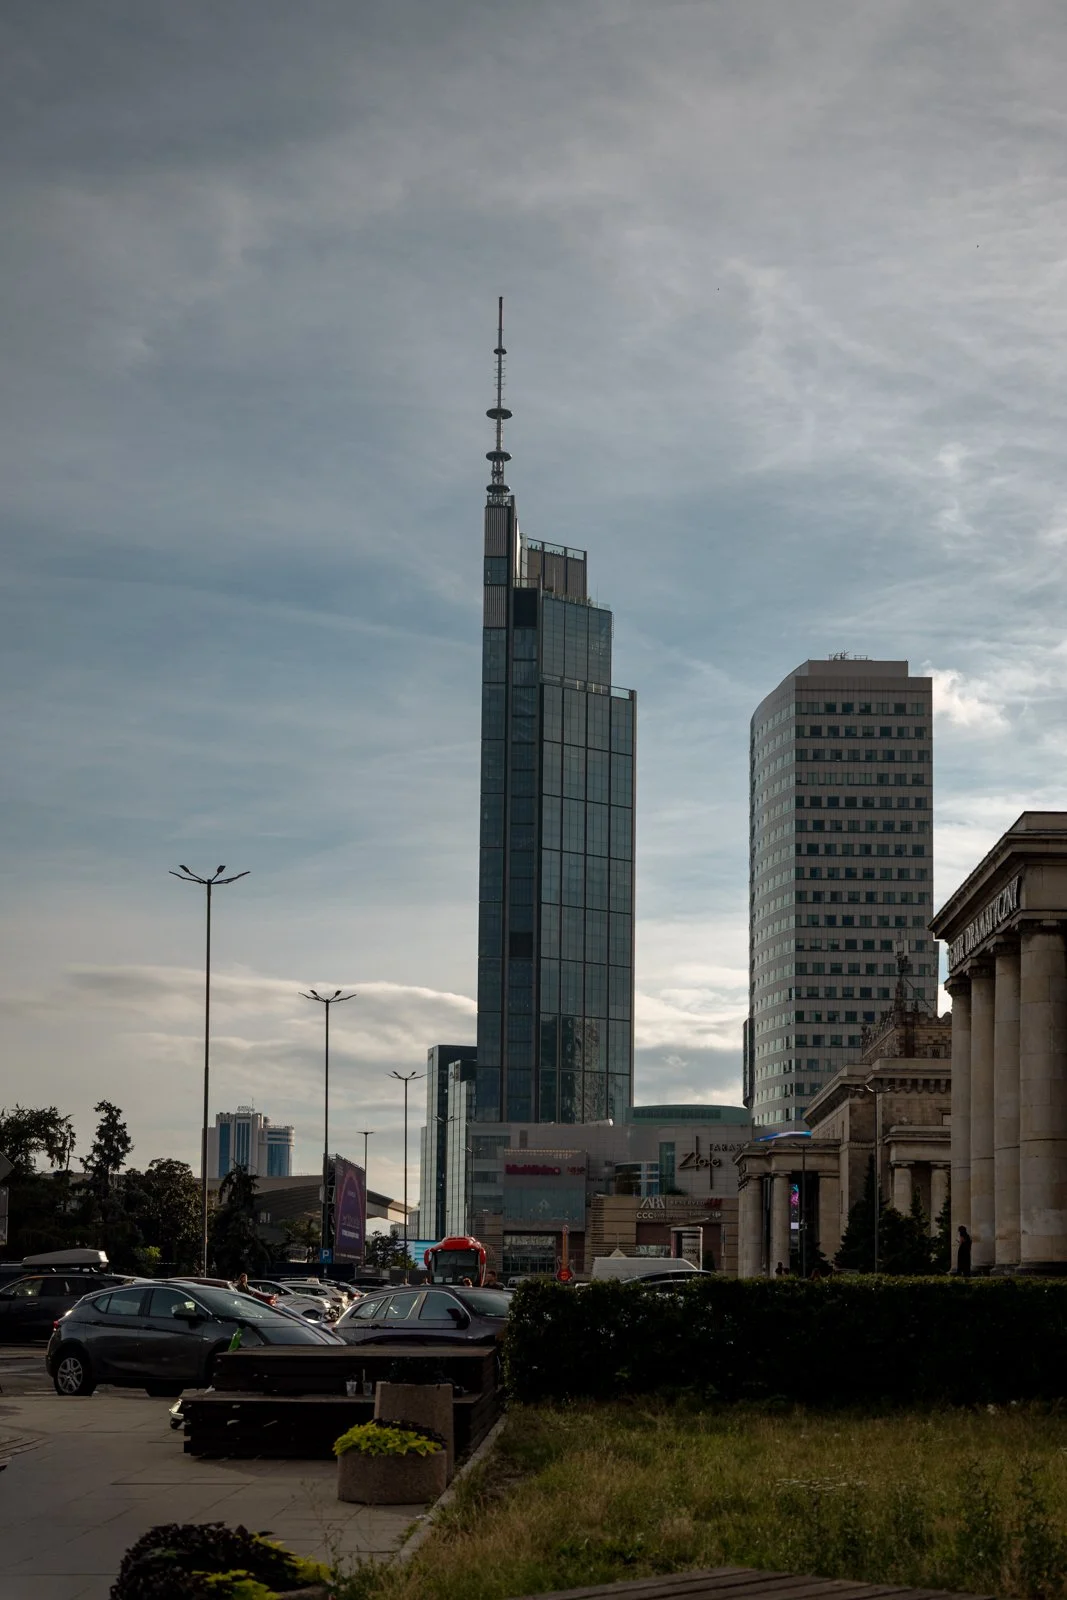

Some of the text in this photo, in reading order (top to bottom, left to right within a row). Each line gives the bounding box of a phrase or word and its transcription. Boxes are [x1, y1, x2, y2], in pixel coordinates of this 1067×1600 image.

[640, 1196, 666, 1209] ZARA
[636, 1211, 654, 1220] CCC
[322, 1249, 330, 1259] P
